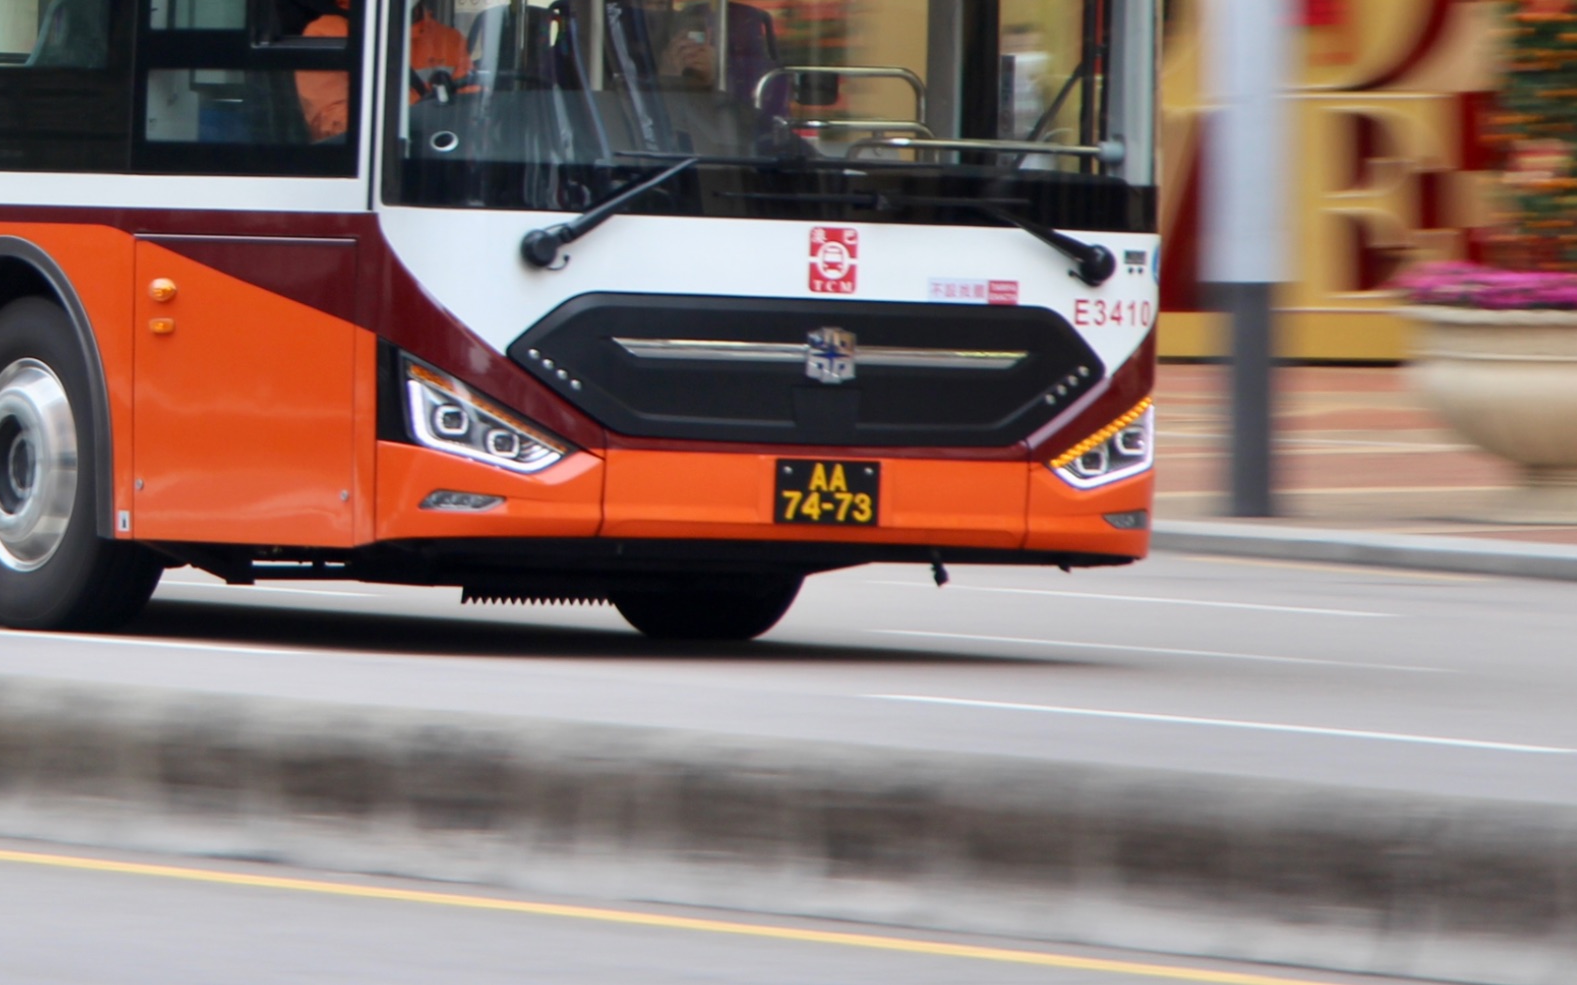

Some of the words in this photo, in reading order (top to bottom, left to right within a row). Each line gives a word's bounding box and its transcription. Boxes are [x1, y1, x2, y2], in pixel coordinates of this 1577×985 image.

[812, 279, 854, 293] TCM
[1074, 299, 1151, 326] E3410
[808, 462, 848, 491] AA
[781, 490, 873, 523] 74-73
